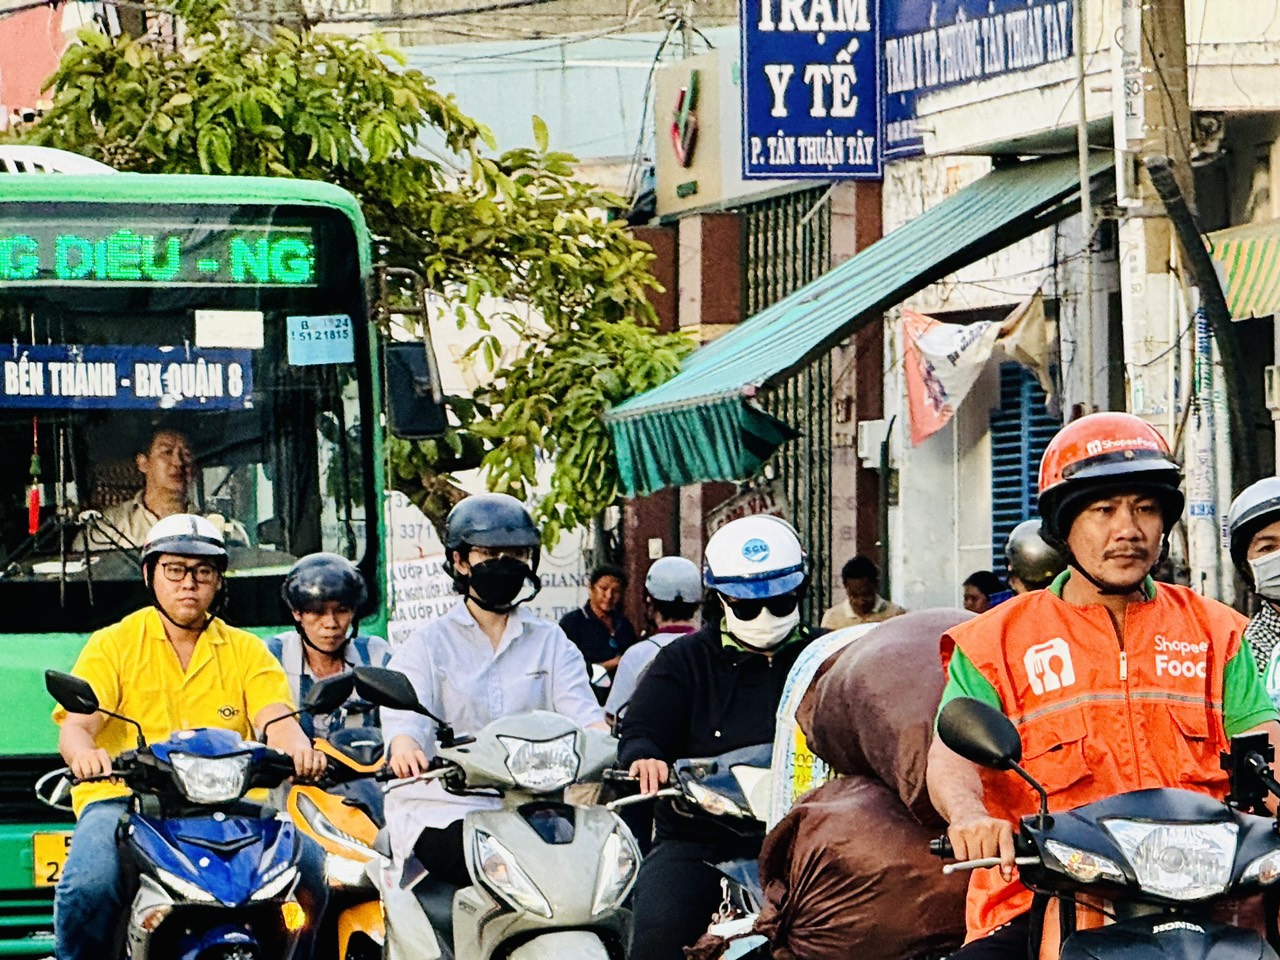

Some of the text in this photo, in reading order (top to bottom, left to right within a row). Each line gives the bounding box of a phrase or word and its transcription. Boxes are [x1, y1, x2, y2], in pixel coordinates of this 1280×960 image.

[764, 37, 860, 117] Y TẾ
[751, 129, 875, 171] P. TÂN THUẬN TÂY
[0, 233, 39, 280] G
[5, 350, 44, 396] BẾN
[48, 355, 117, 396] THÀNH
[135, 363, 163, 397] BX
[227, 363, 244, 397] 8
[1154, 634, 1208, 656] Shopee
[1152, 921, 1205, 934] HONDA
